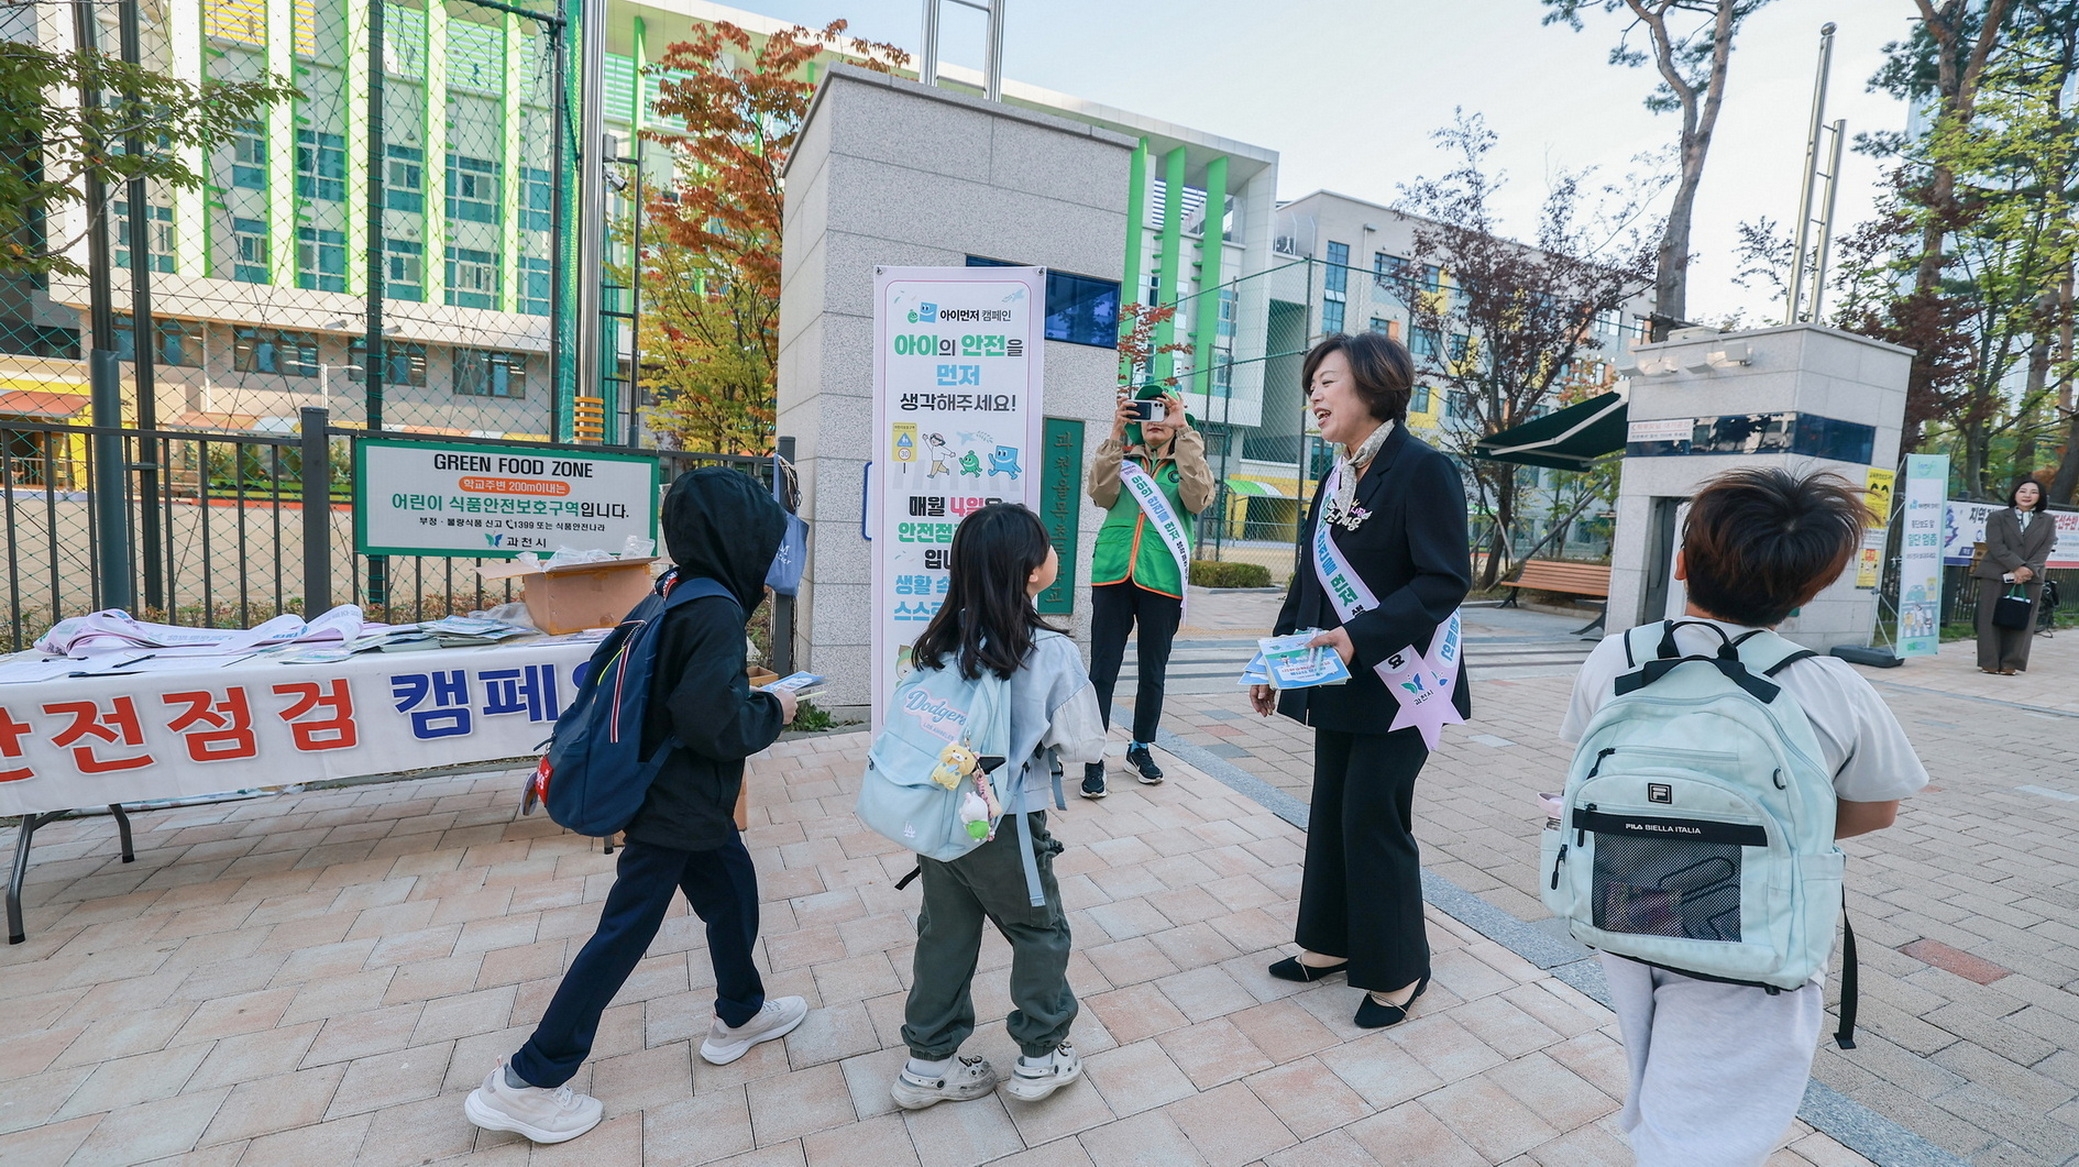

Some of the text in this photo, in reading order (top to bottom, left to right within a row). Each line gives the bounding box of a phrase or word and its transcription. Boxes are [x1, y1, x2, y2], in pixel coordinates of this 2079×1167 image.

[940, 310, 1011, 322] 아이먼저 캠페인
[894, 334, 1023, 356] 아이의 안전을
[937, 364, 980, 386] 먼저
[900, 394, 1016, 411] 생각해주세요!
[434, 454, 593, 478] GREEN FOOD ZONE
[463, 479, 567, 495] 학교주변 200m이내는
[392, 493, 629, 519] 어린이 식품안전보호구역입니다.
[909, 496, 945, 517] 매월
[1132, 475, 1153, 498] 아이의
[1147, 496, 1170, 523] 안전을
[1164, 521, 1180, 541] 먼저
[419, 517, 605, 532] 부정 불량식품 신고 1399 또는 식품안전나라
[898, 522, 959, 543] 안전점
[506, 536, 547, 548] 과천시
[1317, 531, 1338, 576] 안전을
[1331, 573, 1358, 607] 먼저
[895, 575, 932, 595] 생활
[391, 661, 589, 739] 캠페
[906, 690, 967, 725] Dodgers
[1414, 690, 1434, 705] 과천시
[1645, 824, 1674, 832] BIELLA
[1675, 826, 1701, 834] ITALIA
